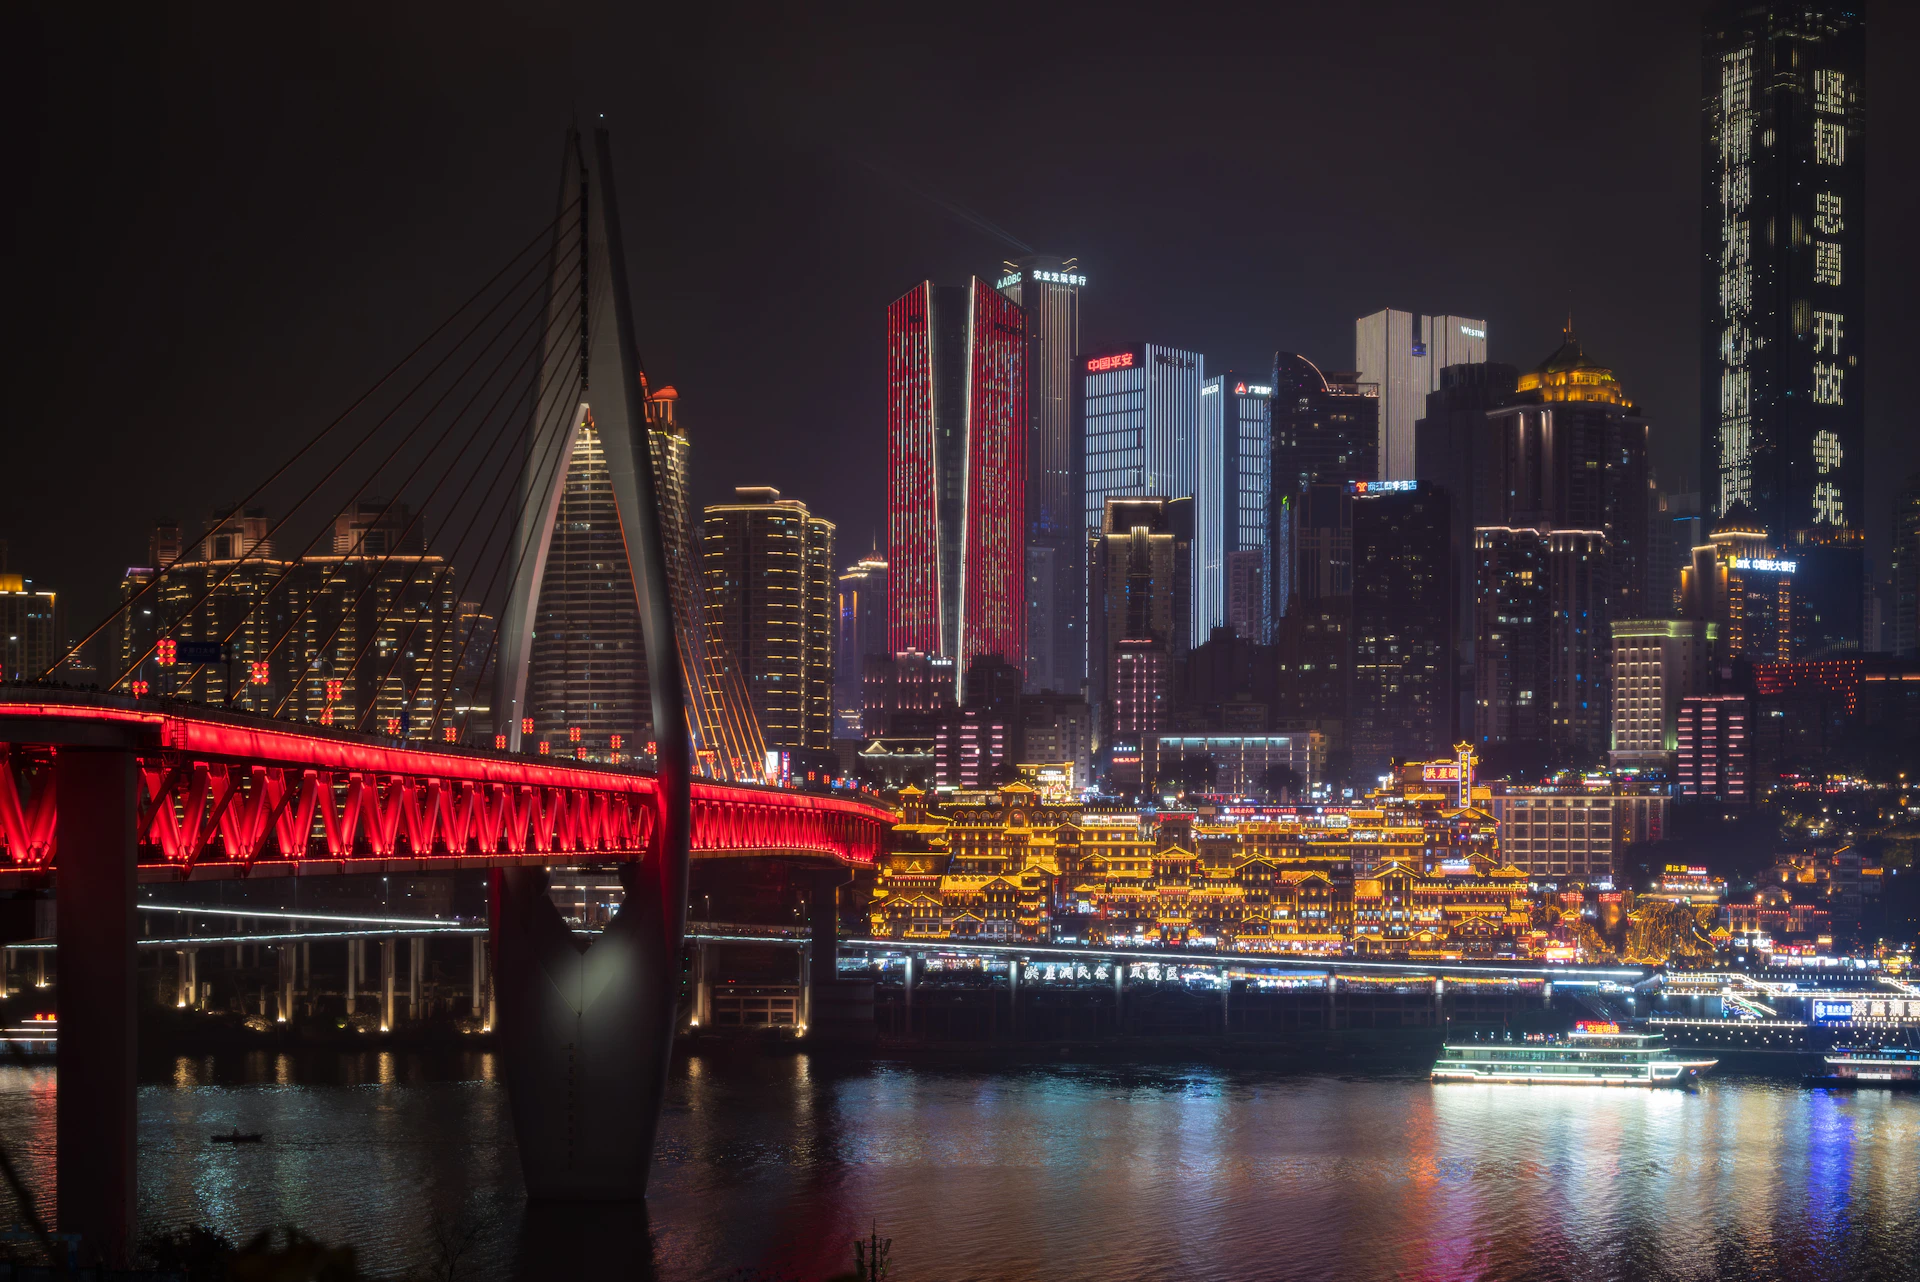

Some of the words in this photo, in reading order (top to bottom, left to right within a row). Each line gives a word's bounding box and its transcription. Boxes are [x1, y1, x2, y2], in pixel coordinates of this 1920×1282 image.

[1813, 68, 1846, 167] 坚韧
[1813, 190, 1844, 287] 忠勇
[1033, 270, 1086, 286] 农业发展银行
[1088, 353, 1132, 371] 中国平安
[1813, 310, 1845, 407] 开放
[1812, 428, 1844, 527] 争先
[1426, 767, 1459, 779] 洪崖洞
[1024, 965, 1109, 980] 洪崖洞民俗
[1129, 966, 1180, 980] 风貌区
